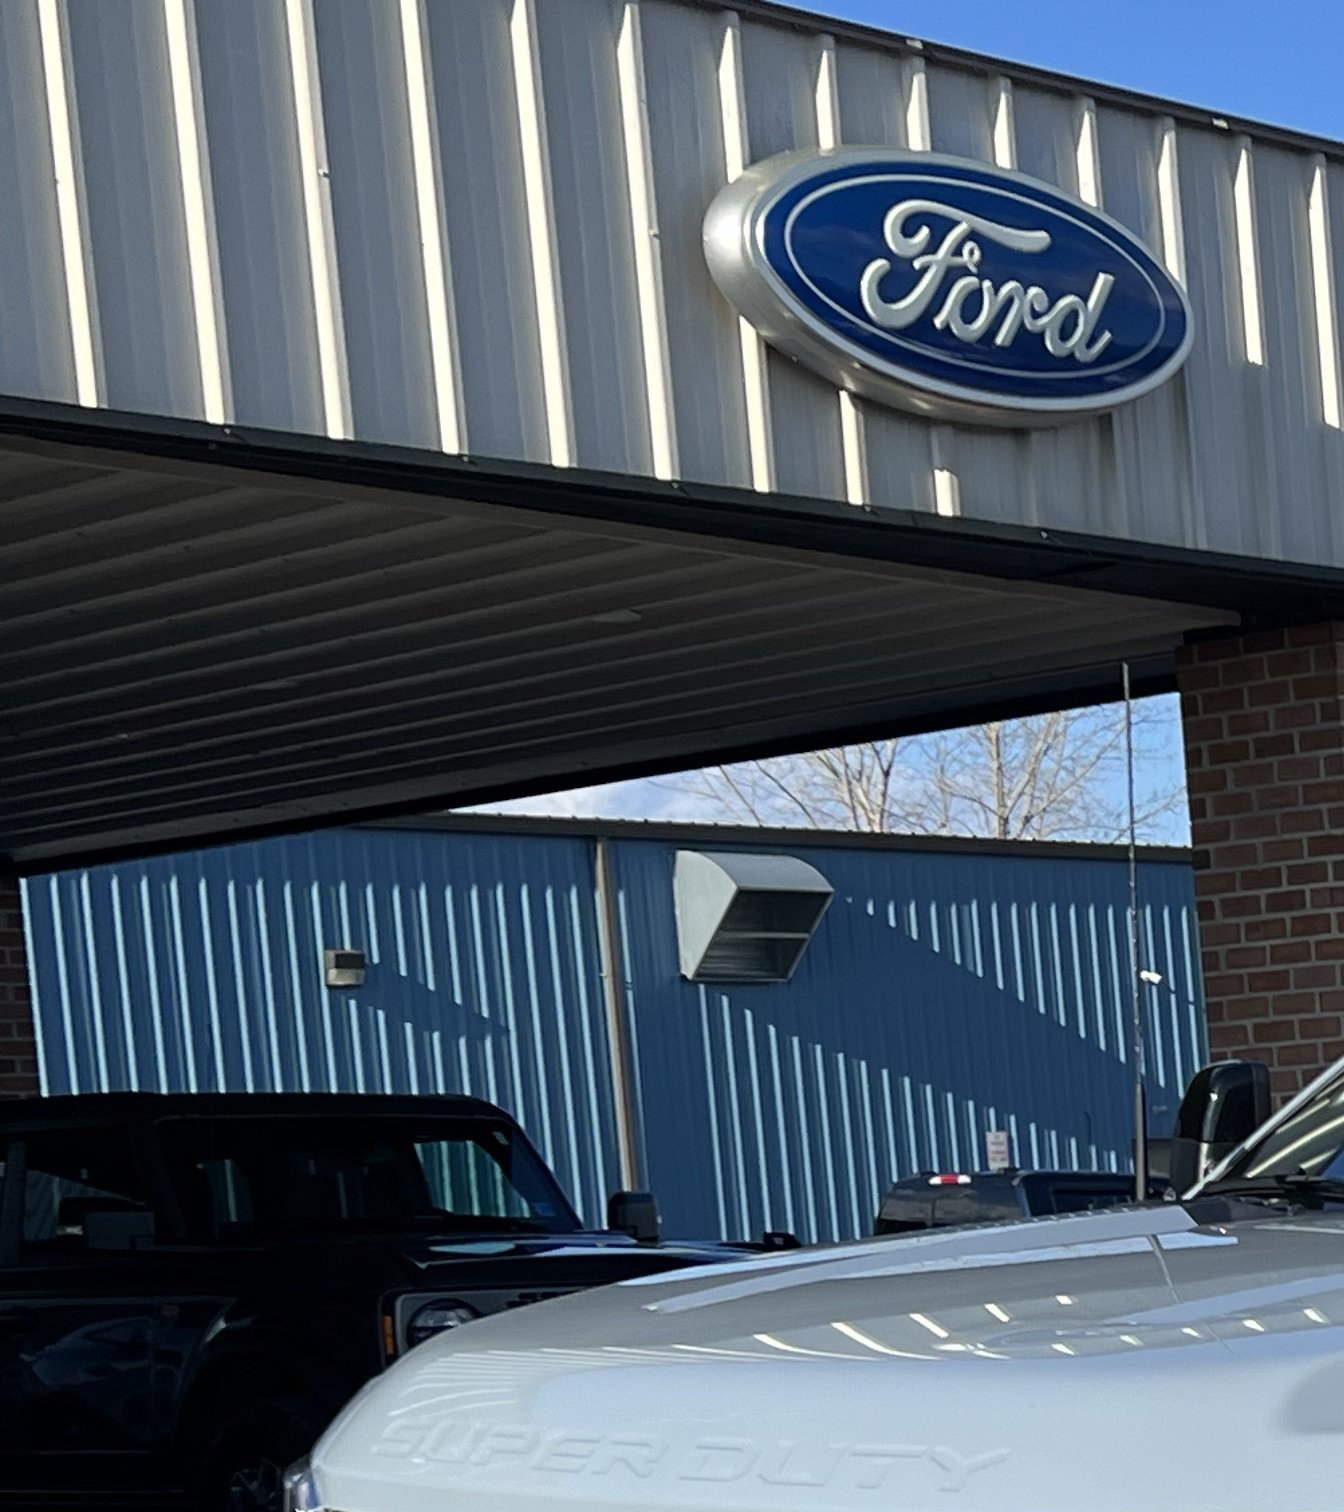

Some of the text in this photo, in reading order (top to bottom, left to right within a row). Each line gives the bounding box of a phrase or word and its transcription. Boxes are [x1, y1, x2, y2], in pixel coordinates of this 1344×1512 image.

[860, 199, 1115, 363] Ford
[372, 1416, 1013, 1493] SUPER DUTY
